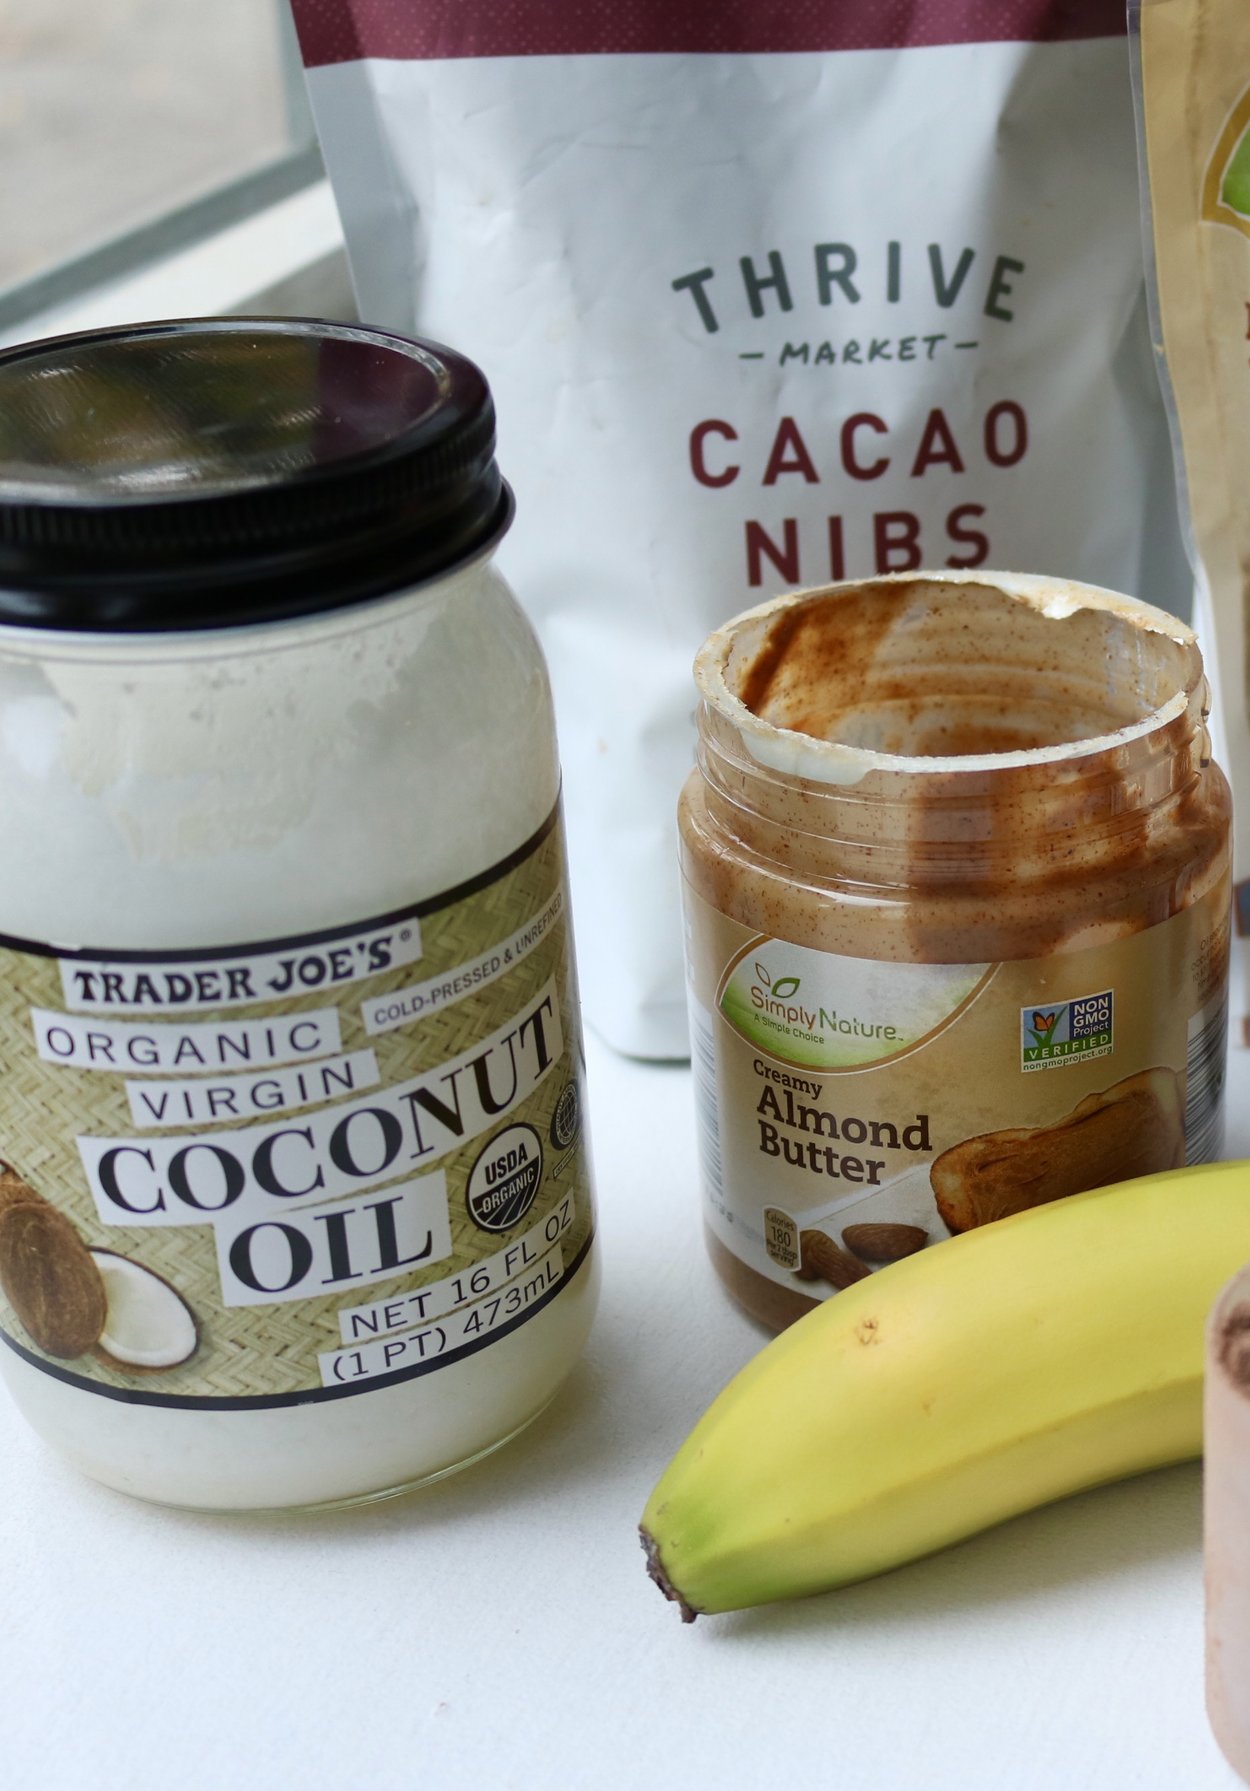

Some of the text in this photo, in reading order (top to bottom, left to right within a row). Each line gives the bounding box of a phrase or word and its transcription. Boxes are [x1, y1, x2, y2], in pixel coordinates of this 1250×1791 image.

[671, 240, 1025, 334] THRIVE
[779, 334, 947, 367] MARKET
[689, 400, 1028, 489] CACAO
[745, 503, 990, 587] NIBS
[74, 934, 393, 1004] TRADER JOE'S
[374, 893, 562, 1025] COLD-PRESSED & UNREFINED
[754, 1013, 825, 1045] A Simple Choice
[1073, 1009, 1109, 1028] GMO
[1073, 1021, 1109, 1038] Project
[1074, 997, 1109, 1016] NON
[46, 1021, 322, 1066] ORGANIC
[1023, 1045, 1113, 1071] nongmoproject.org
[1029, 1034, 1109, 1060] VERIFIED
[98, 996, 554, 1215] COCONUT
[140, 1061, 355, 1120] VIRGIN
[753, 1059, 823, 1100] Creamy
[757, 1085, 933, 1153] Almond
[485, 1142, 528, 1185] USDA
[758, 1120, 885, 1186] Butter
[482, 1167, 535, 1213] ORGANIC
[228, 1196, 432, 1294] OIL
[770, 1226, 791, 1247] 180
[351, 1200, 571, 1338] NET 16 FL OZ
[333, 1261, 559, 1381] (1 PT) 473mL
